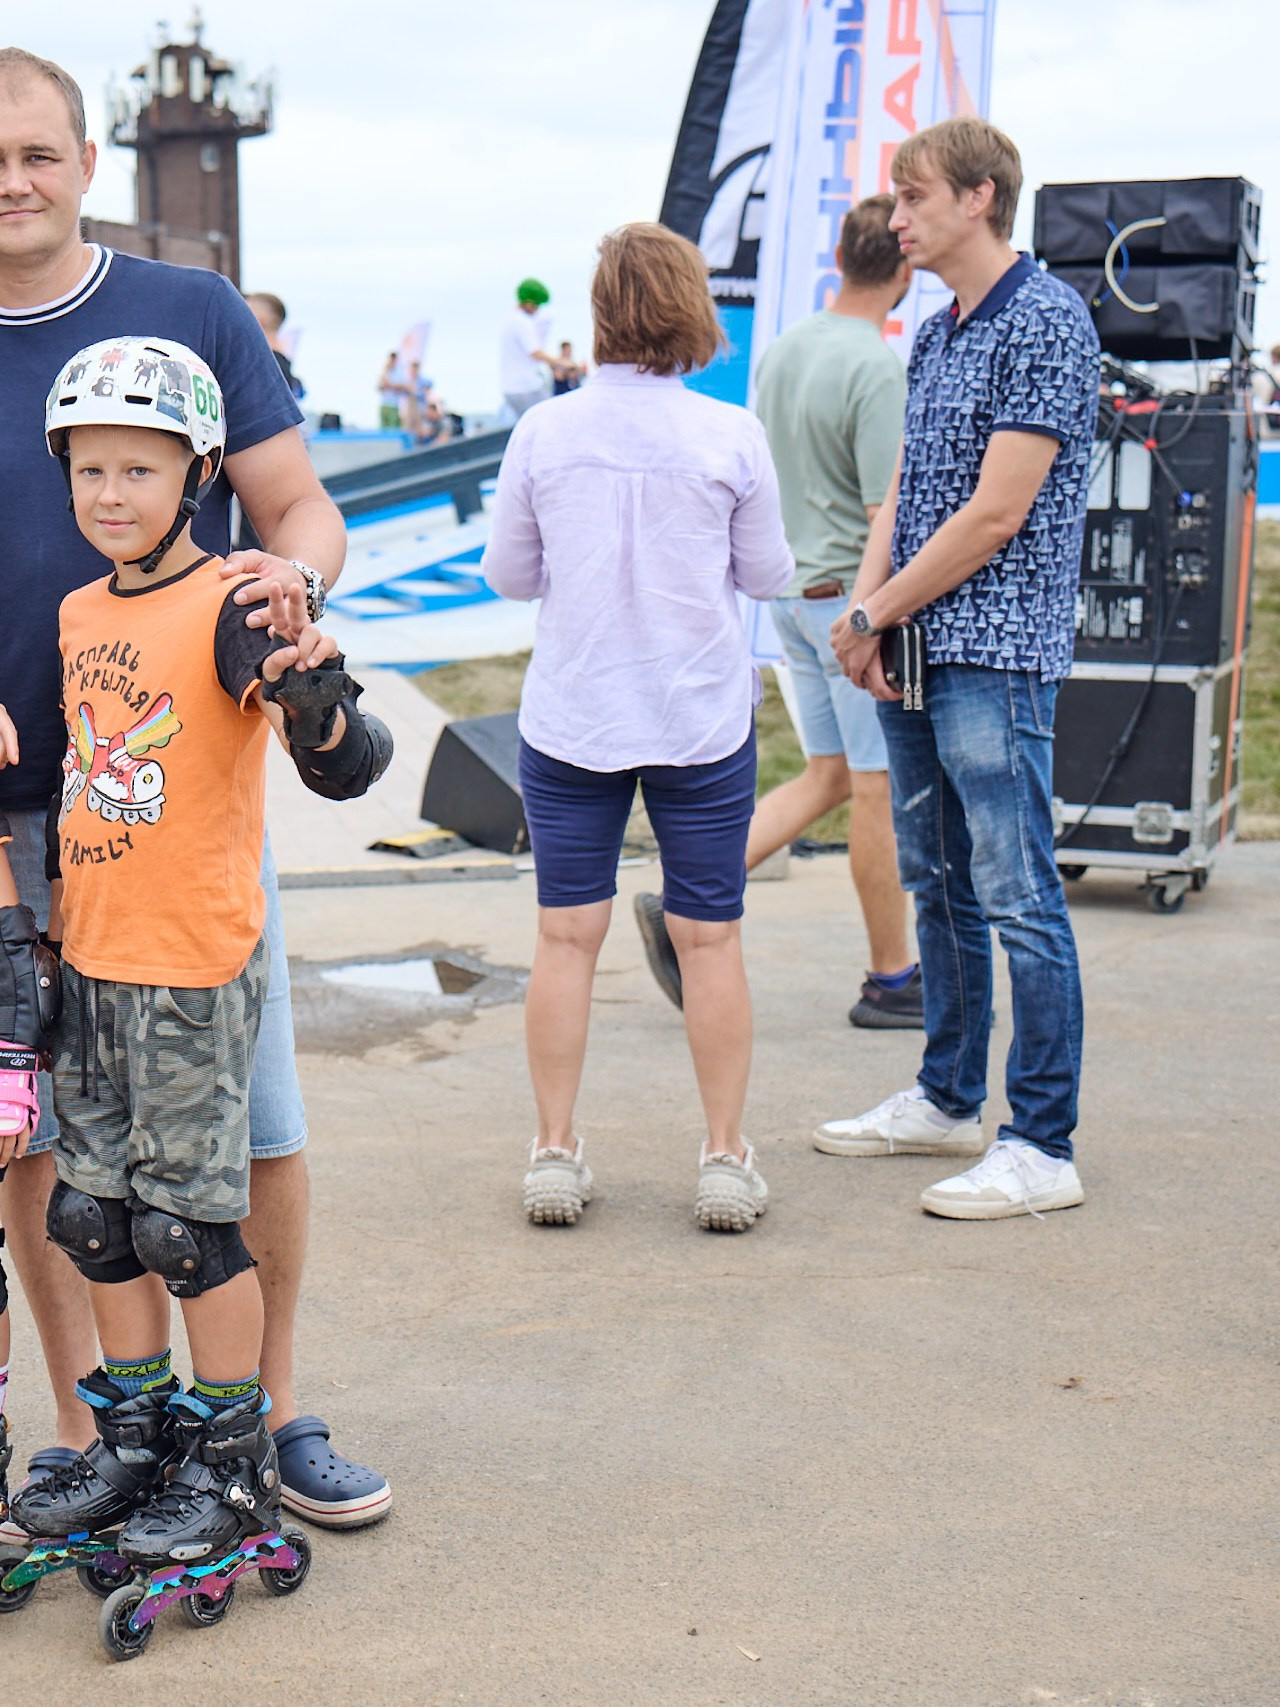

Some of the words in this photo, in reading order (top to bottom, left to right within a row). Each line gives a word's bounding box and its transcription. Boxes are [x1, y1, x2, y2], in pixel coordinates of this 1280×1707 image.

[193, 374, 218, 421] 66
[64, 640, 141, 687] АСПРАВЬ
[79, 668, 150, 713] КРЫЛЬЯ
[63, 831, 134, 865] FAMILY
